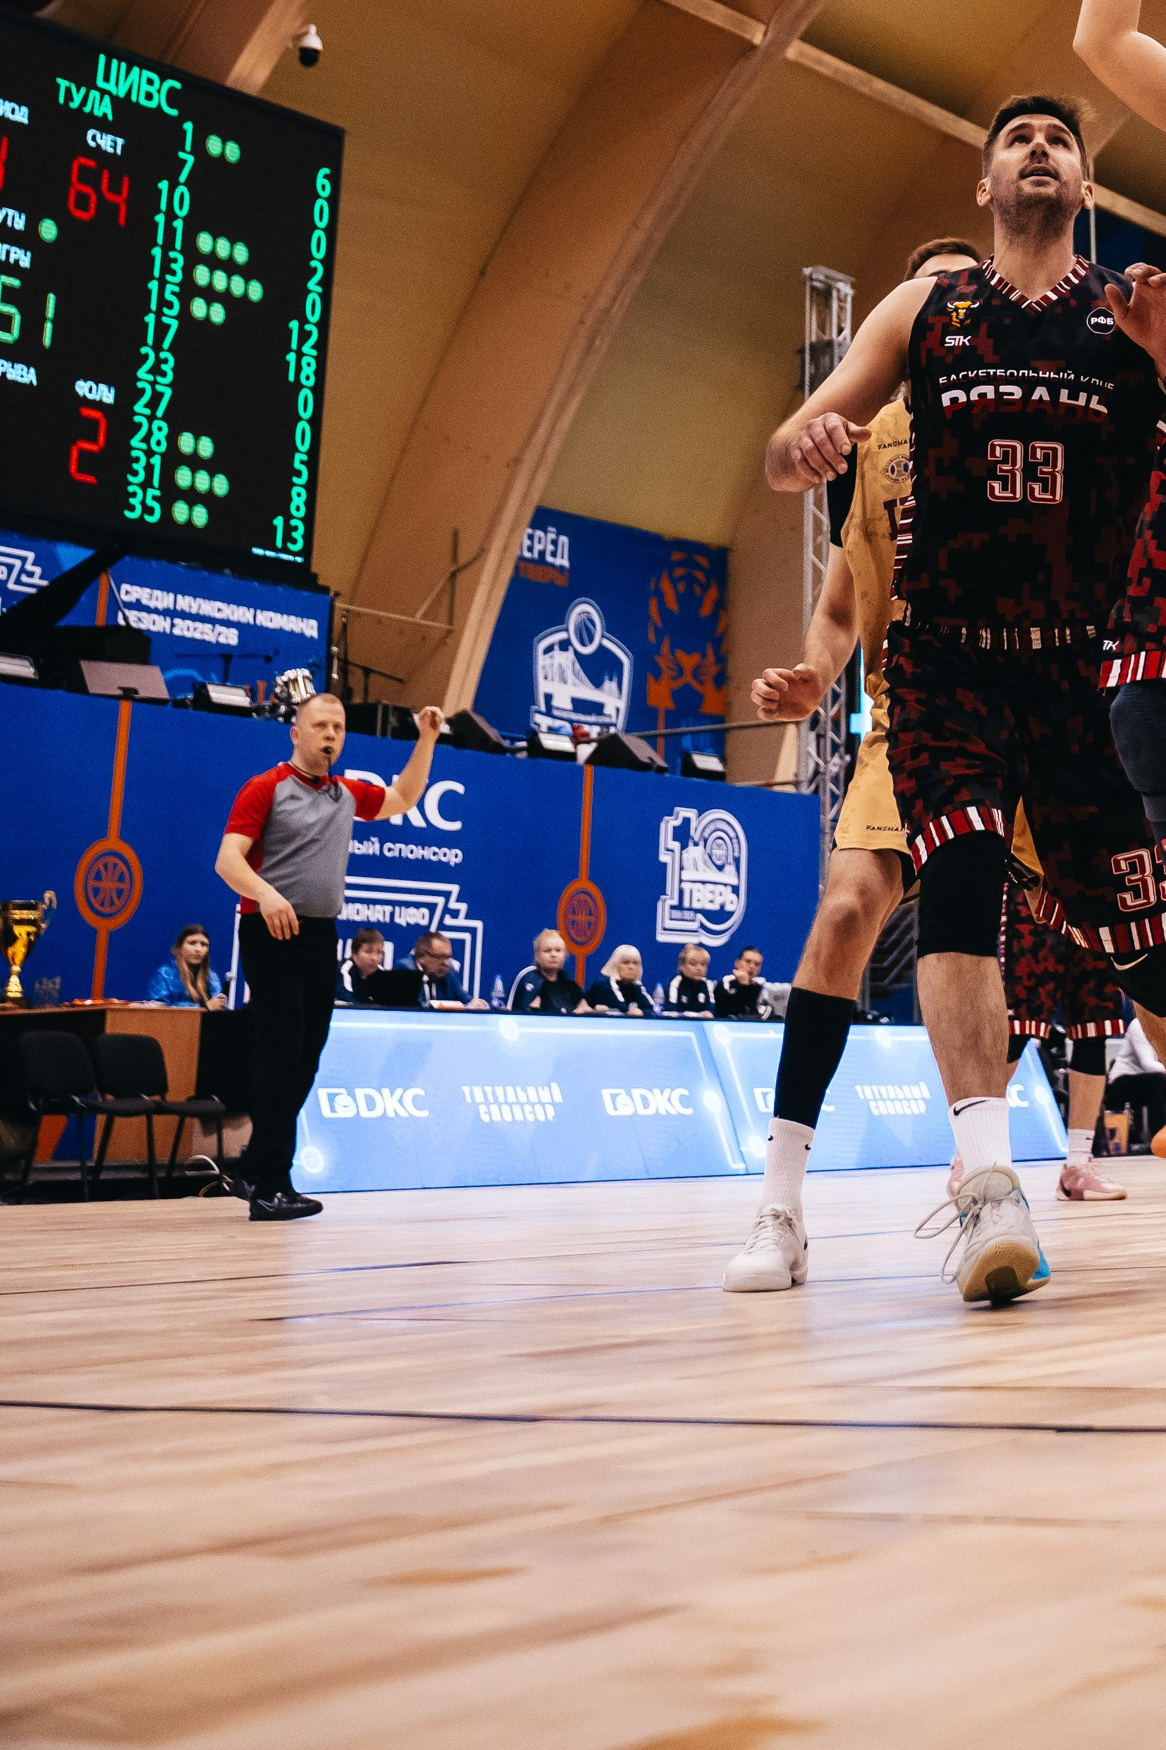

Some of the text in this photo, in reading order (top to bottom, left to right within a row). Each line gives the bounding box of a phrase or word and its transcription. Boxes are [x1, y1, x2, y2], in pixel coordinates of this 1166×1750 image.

[55, 77, 113, 122] ТУЛА
[96, 53, 182, 117] ЦИВС
[0, 98, 29, 125] ИОД
[86, 128, 125, 156] СЧЕТ
[182, 120, 332, 199] 1 6
[67, 156, 130, 227] 64
[177, 151, 330, 229] 7 0
[157, 179, 327, 260] 10 0
[0, 243, 32, 269] ГРЫ
[153, 212, 324, 293] 11 2
[150, 245, 321, 324] 13 0
[147, 279, 319, 357] 15 12
[1091, 315, 1114, 326] РФБ
[143, 312, 317, 388] 17 18
[944, 335, 972, 347] STK
[0, 359, 38, 386] РЫВА
[136, 345, 314, 420] 23 0
[133, 380, 312, 453] 27 0
[940, 384, 1109, 424] РЯЗАНЬ
[69, 406, 107, 485] 2
[129, 414, 309, 486] 28 5
[877, 439, 910, 450] FANSHA
[126, 449, 308, 519] 31 8
[986, 439, 1065, 505] 33
[123, 484, 305, 552] 35 13
[522, 525, 570, 569] ЕРЁД
[171, 617, 240, 646] 2025/26
[1102, 639, 1121, 651] TK
[382, 841, 463, 867] спонсор
[337, 902, 393, 924] ИОНАТ
[680, 881, 740, 912] ТВЕРЬ
[356, 1088, 430, 1118] DKC
[627, 1087, 694, 1116] DKC
